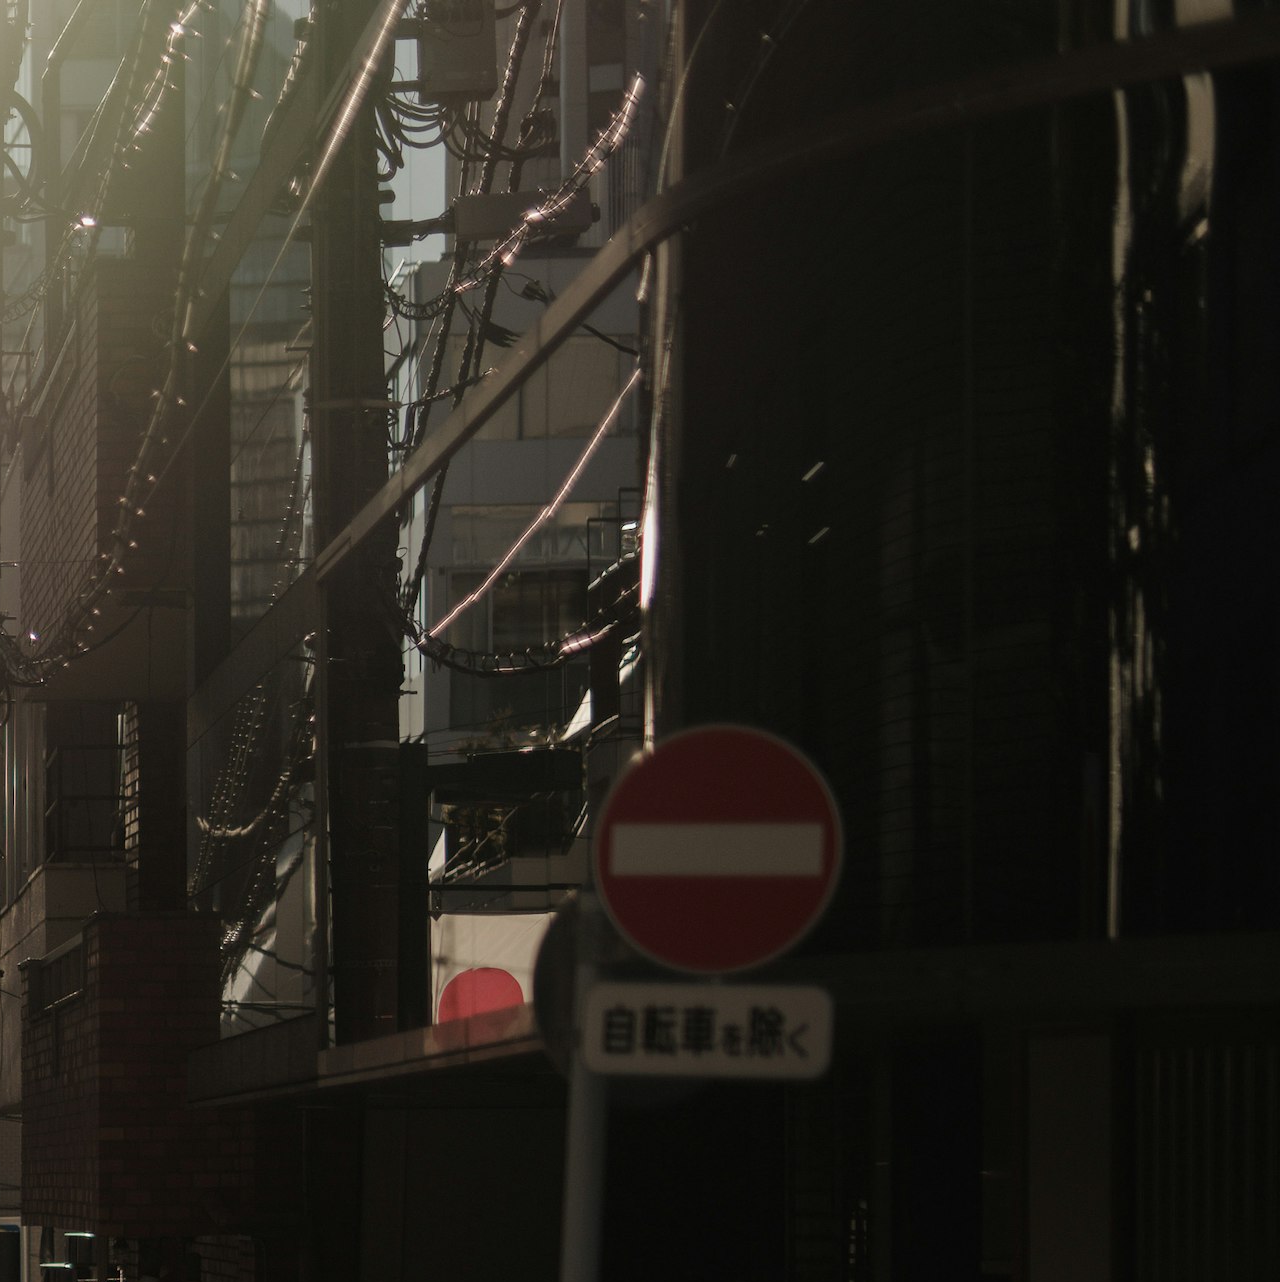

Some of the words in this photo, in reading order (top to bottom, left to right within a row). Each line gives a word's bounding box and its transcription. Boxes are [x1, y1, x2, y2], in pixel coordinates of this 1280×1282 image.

[604, 1005, 809, 1057] 自転車を除く
